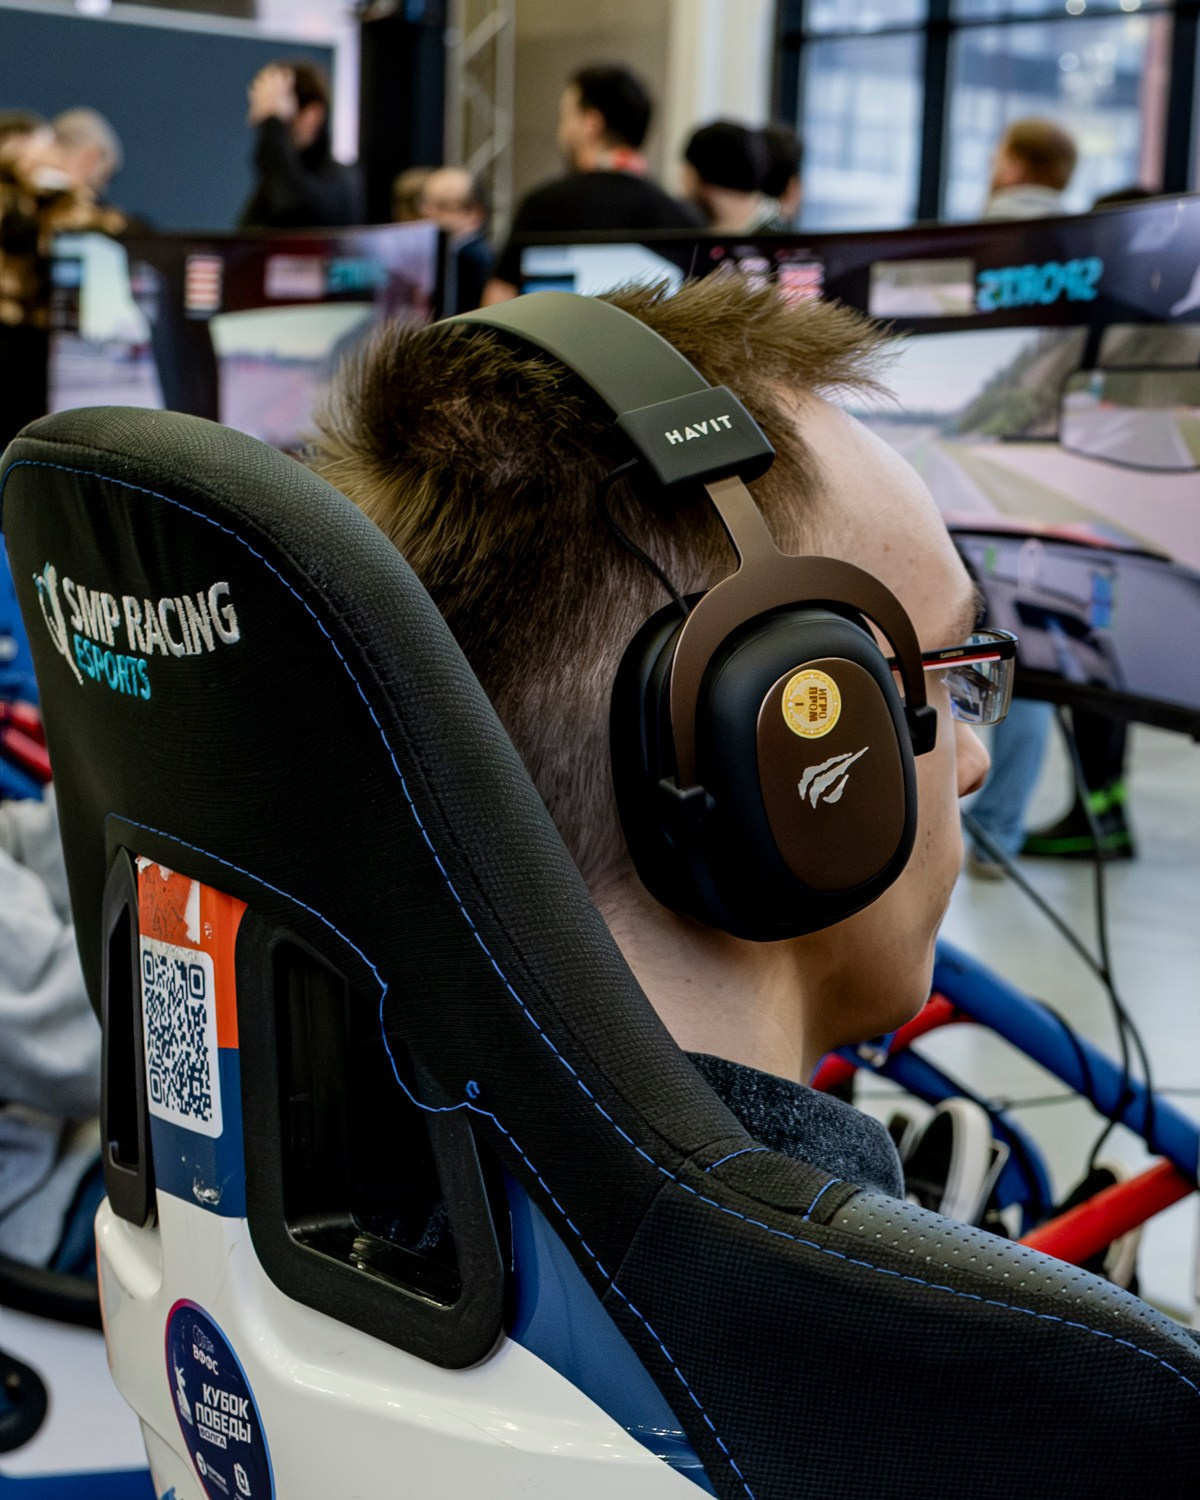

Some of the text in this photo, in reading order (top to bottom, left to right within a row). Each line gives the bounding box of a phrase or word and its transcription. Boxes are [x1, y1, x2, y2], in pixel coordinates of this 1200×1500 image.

[664, 414, 733, 445] HAVIT
[62, 576, 241, 658] SMP RACING
[73, 632, 152, 700] ESPORTS
[808, 686, 818, 722] ПРОМ
[818, 688, 828, 719] ИГРО
[191, 1343, 219, 1376] ВФФС
[202, 1383, 249, 1420] КУБОК
[195, 1401, 252, 1443] ПОБЕДЫ
